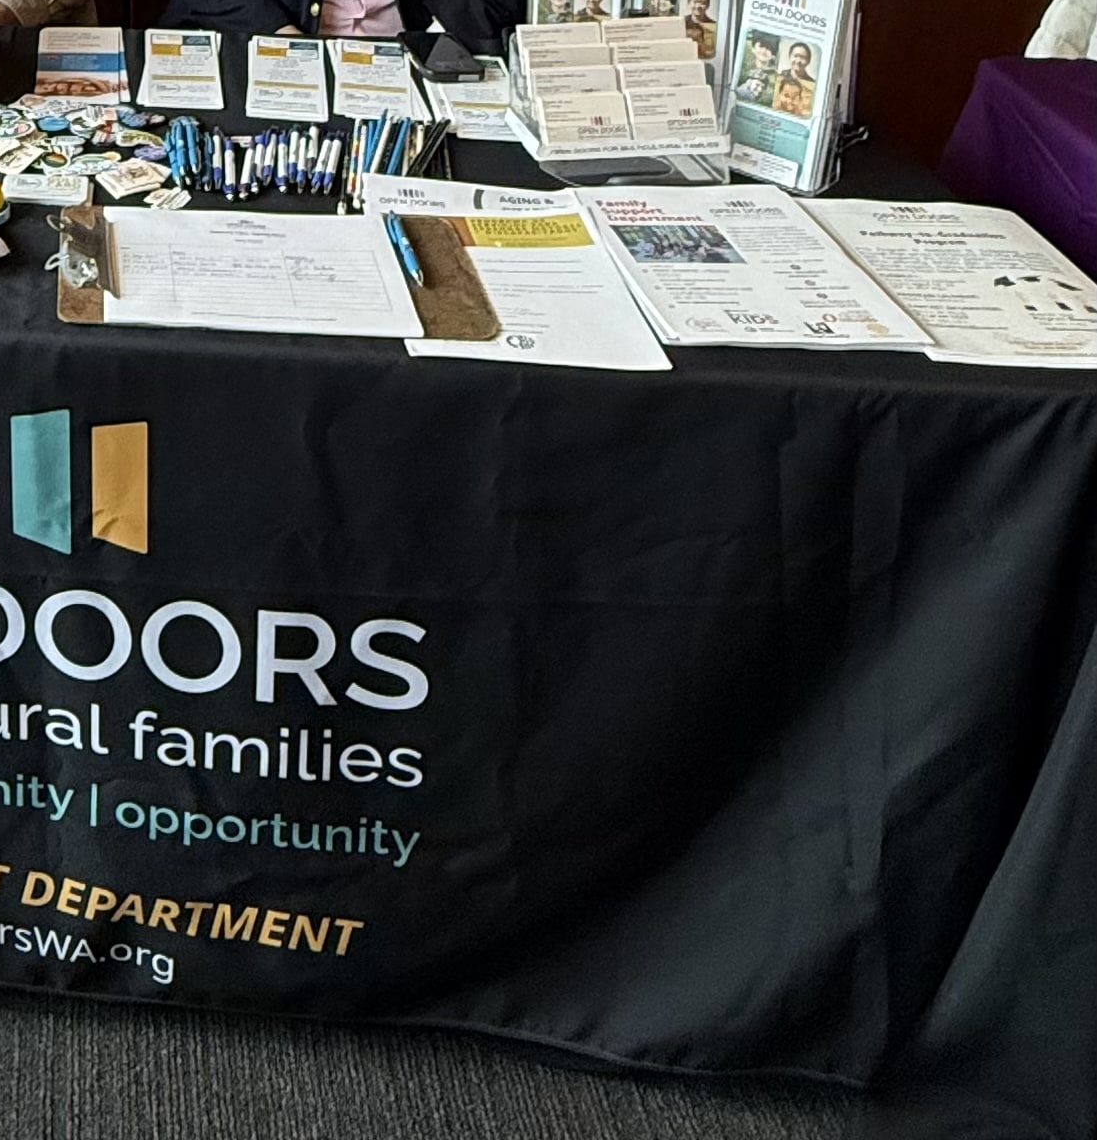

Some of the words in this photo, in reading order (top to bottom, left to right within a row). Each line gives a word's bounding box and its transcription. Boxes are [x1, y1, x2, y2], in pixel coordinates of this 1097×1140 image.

[751, 0, 784, 17] OPEN
[785, 8, 828, 28] DOORS
[499, 195, 541, 205] AGING
[596, 199, 647, 208] Family
[608, 214, 704, 222] Department
[129, 710, 424, 788] families
[114, 800, 421, 868] opportunity
[20, 869, 364, 956] DEPARTMENT
